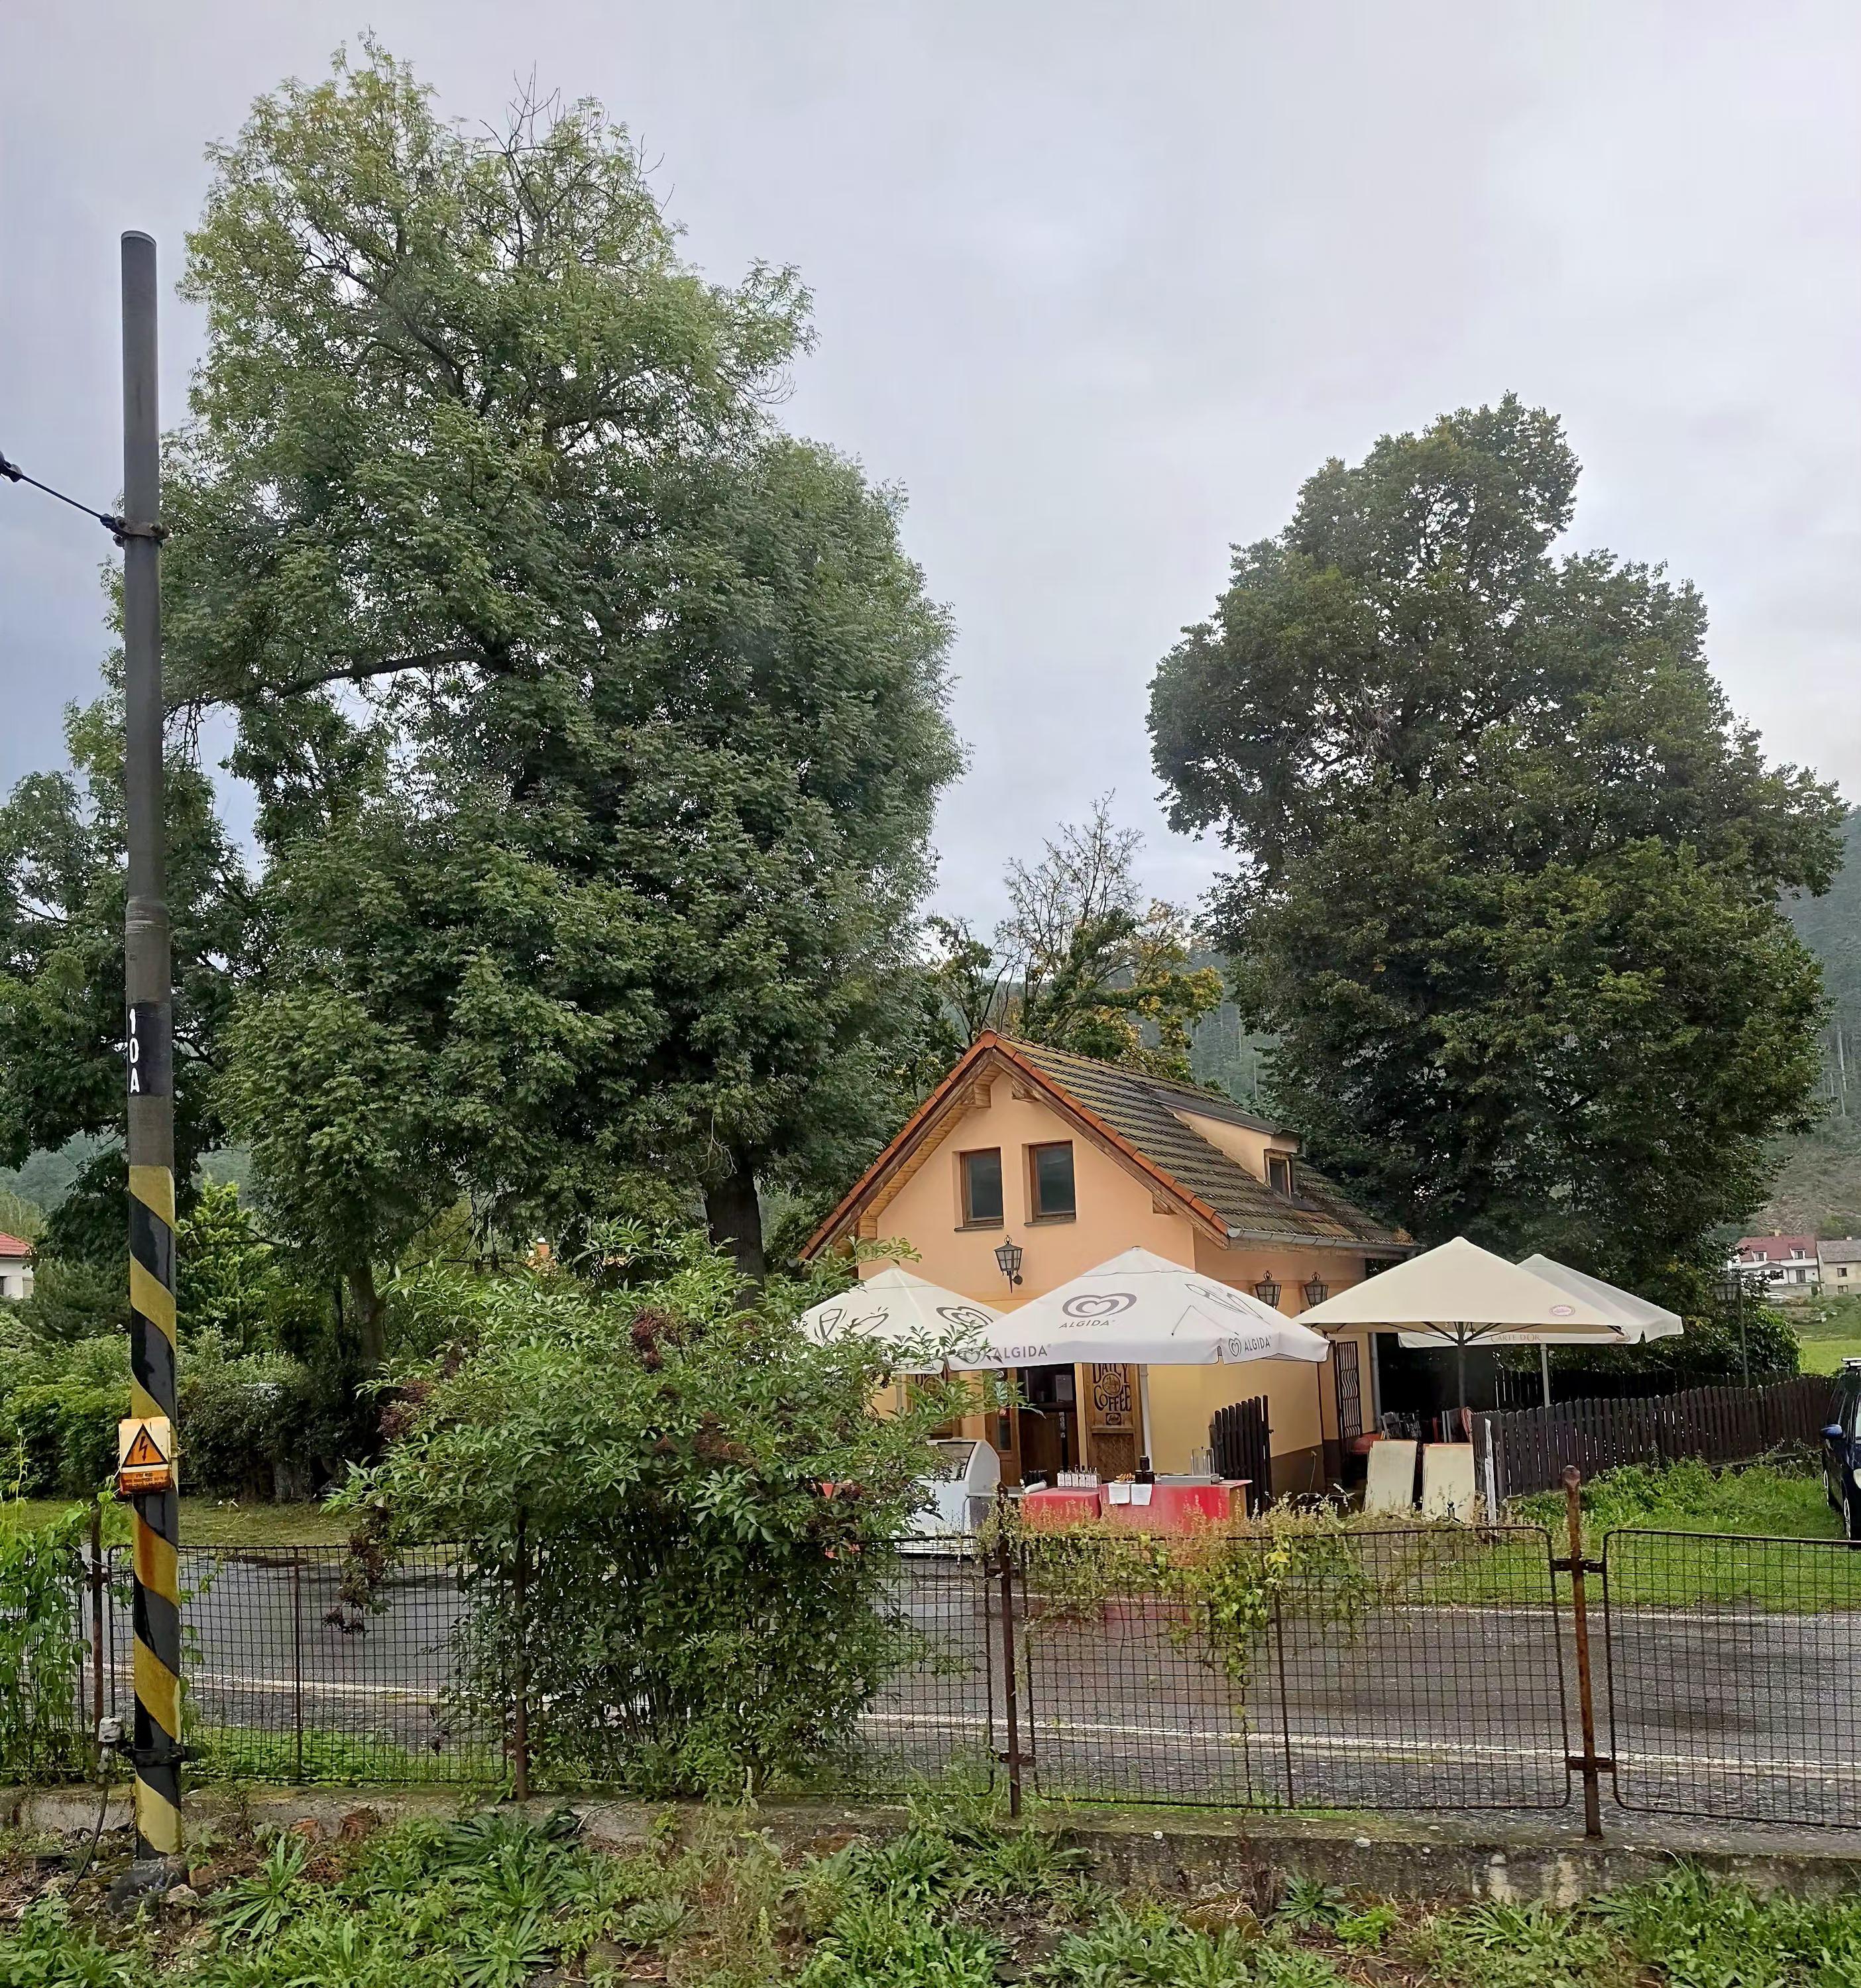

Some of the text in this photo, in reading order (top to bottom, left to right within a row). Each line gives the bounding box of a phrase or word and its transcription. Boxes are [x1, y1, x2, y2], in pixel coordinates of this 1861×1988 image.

[1058, 1319, 1109, 1329] ALGIDA
[1244, 1336, 1270, 1352] ALGIDA
[1491, 1334, 1517, 1343] CARTE
[993, 1345, 1047, 1359] ALGIDA
[1094, 1385, 1131, 1411] COFFEE
